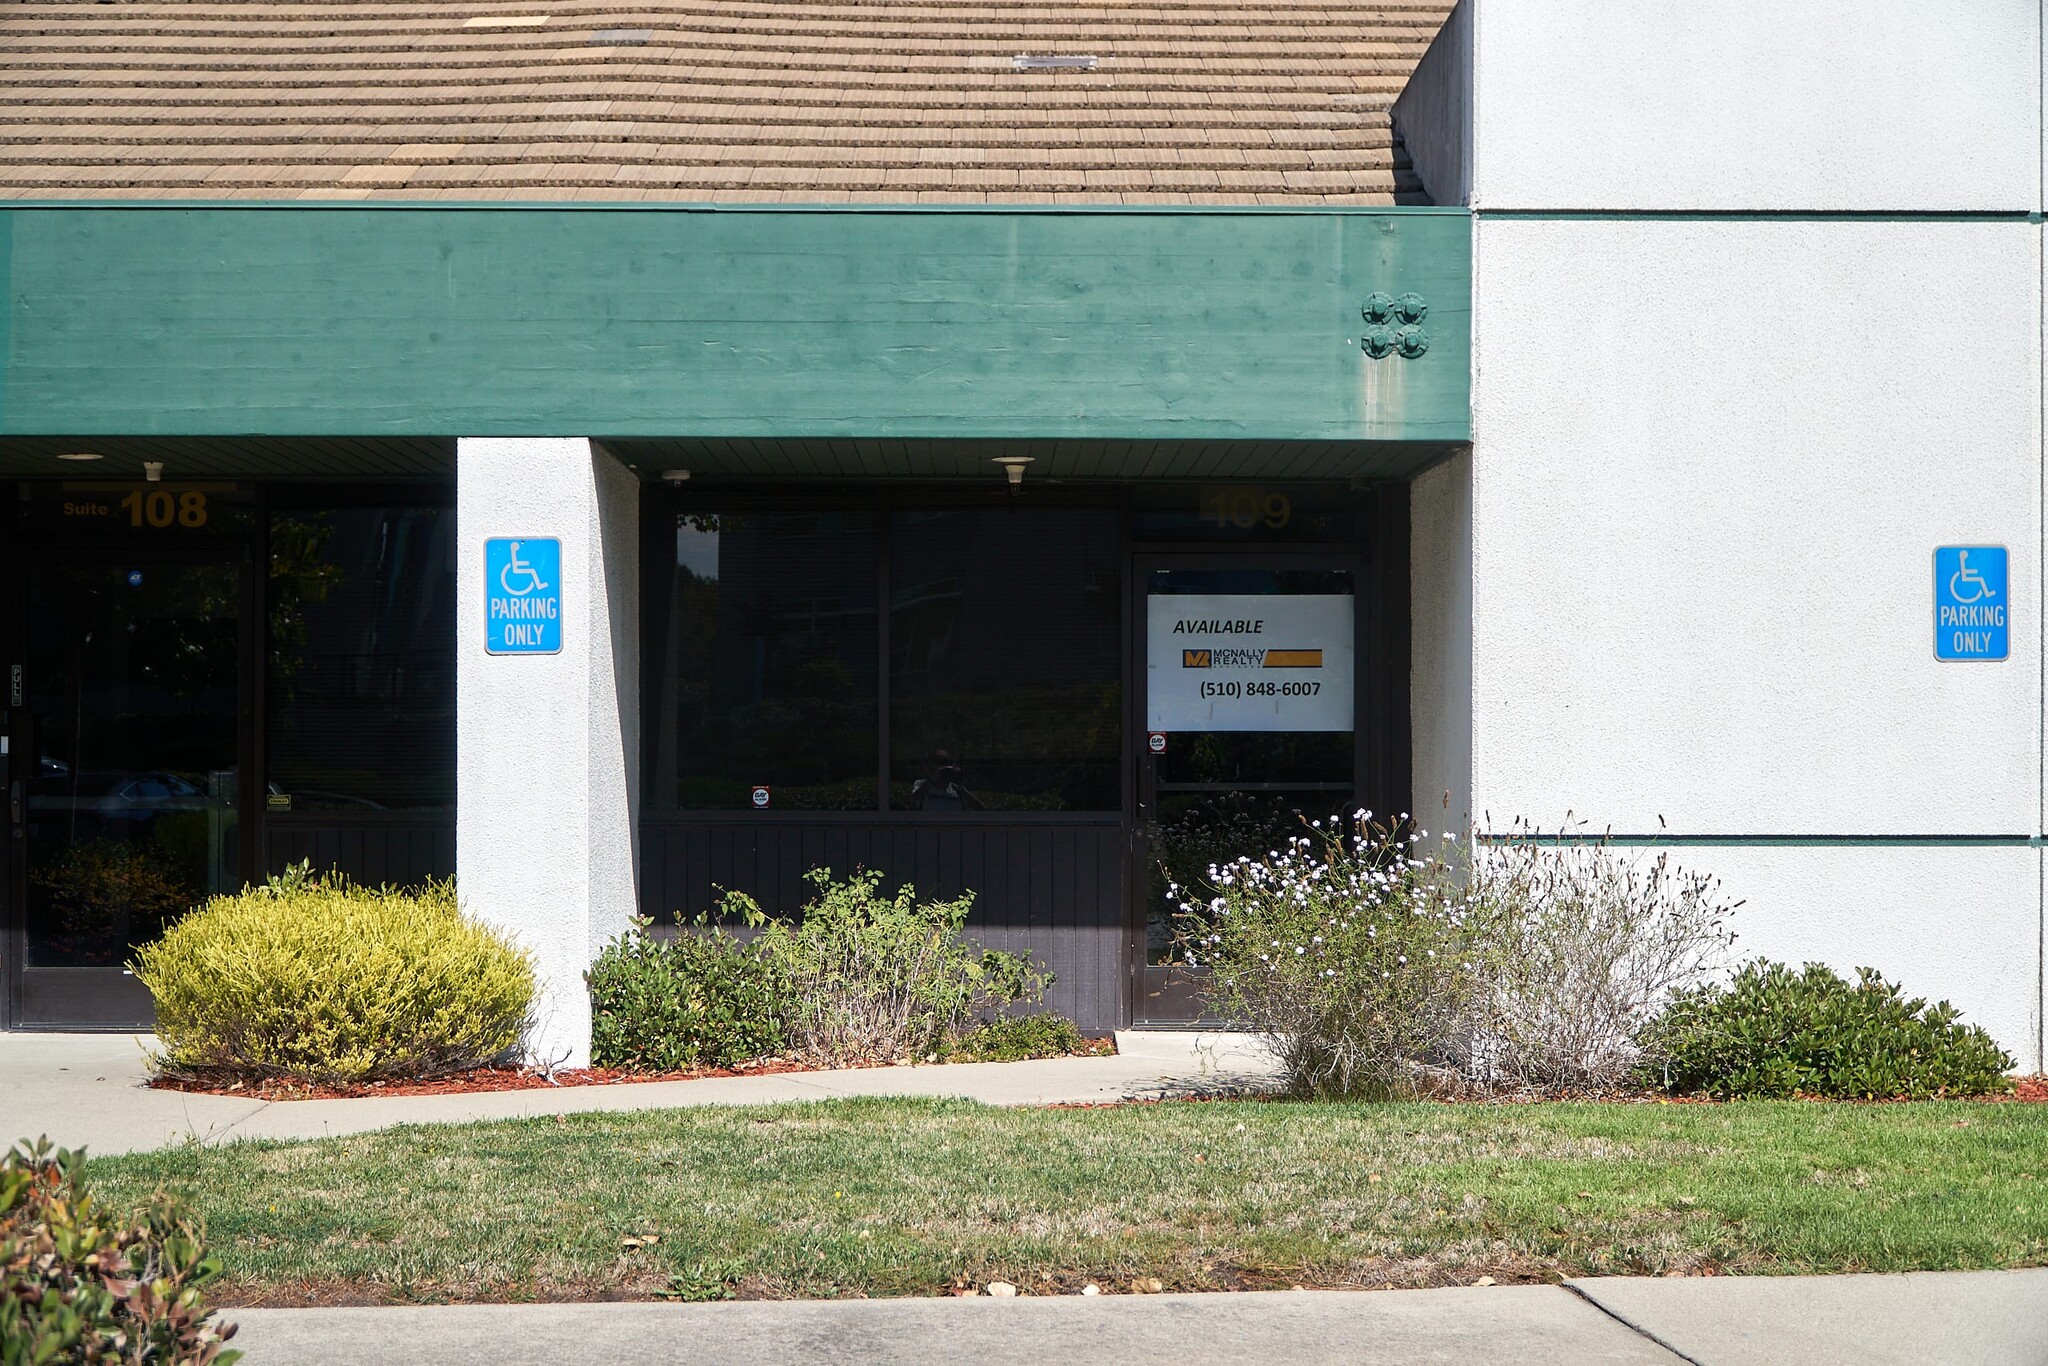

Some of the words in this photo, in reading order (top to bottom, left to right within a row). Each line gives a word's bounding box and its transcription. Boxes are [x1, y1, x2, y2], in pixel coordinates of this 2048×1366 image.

[63, 502, 108, 517] Suite
[121, 490, 208, 528] 108
[1208, 491, 1290, 528] 109
[491, 597, 556, 619] PARKING
[1940, 605, 2004, 627] PARKING
[504, 624, 544, 645] ONLY
[1173, 620, 1264, 634] AVAILABLE
[1953, 631, 1992, 652] ONLY
[1213, 649, 1266, 657] MCNALLY
[1213, 657, 1263, 665] REALTY
[1200, 681, 1241, 699] (510)
[1246, 682, 1321, 696] 848-6007
